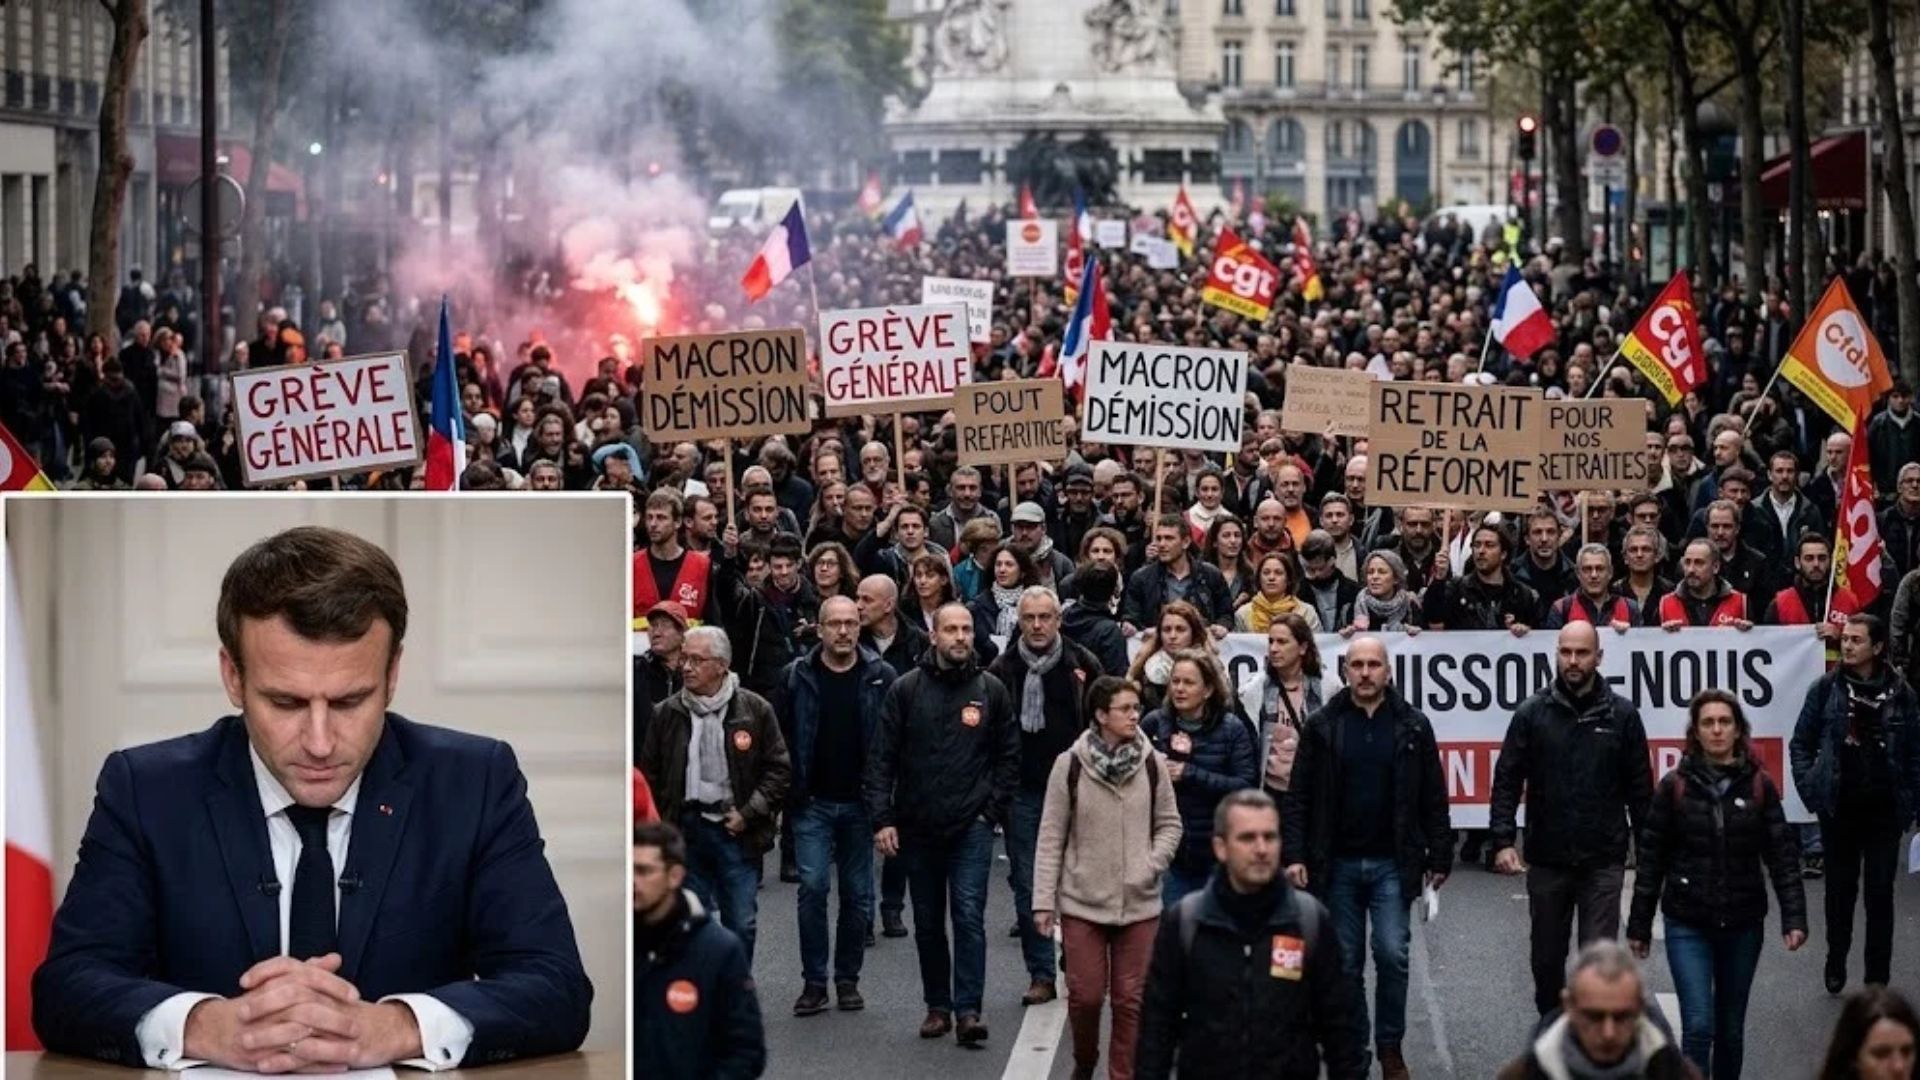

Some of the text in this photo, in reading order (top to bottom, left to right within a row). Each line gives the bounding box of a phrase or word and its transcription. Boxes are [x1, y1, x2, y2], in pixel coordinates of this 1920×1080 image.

[828, 309, 954, 354] GRÈVE
[654, 336, 797, 380] MACRON
[1100, 350, 1239, 393] MACRON
[248, 365, 394, 418] GRÈVE
[974, 388, 1043, 416] POUT
[1381, 388, 1532, 431] RETRAIT
[1551, 407, 1614, 429] POUR
[1564, 432, 1601, 447] NOS
[246, 411, 412, 470] GÉNÉRALE
[1421, 430, 1488, 452] DE LA
[1376, 448, 1532, 498] RÉFORME
